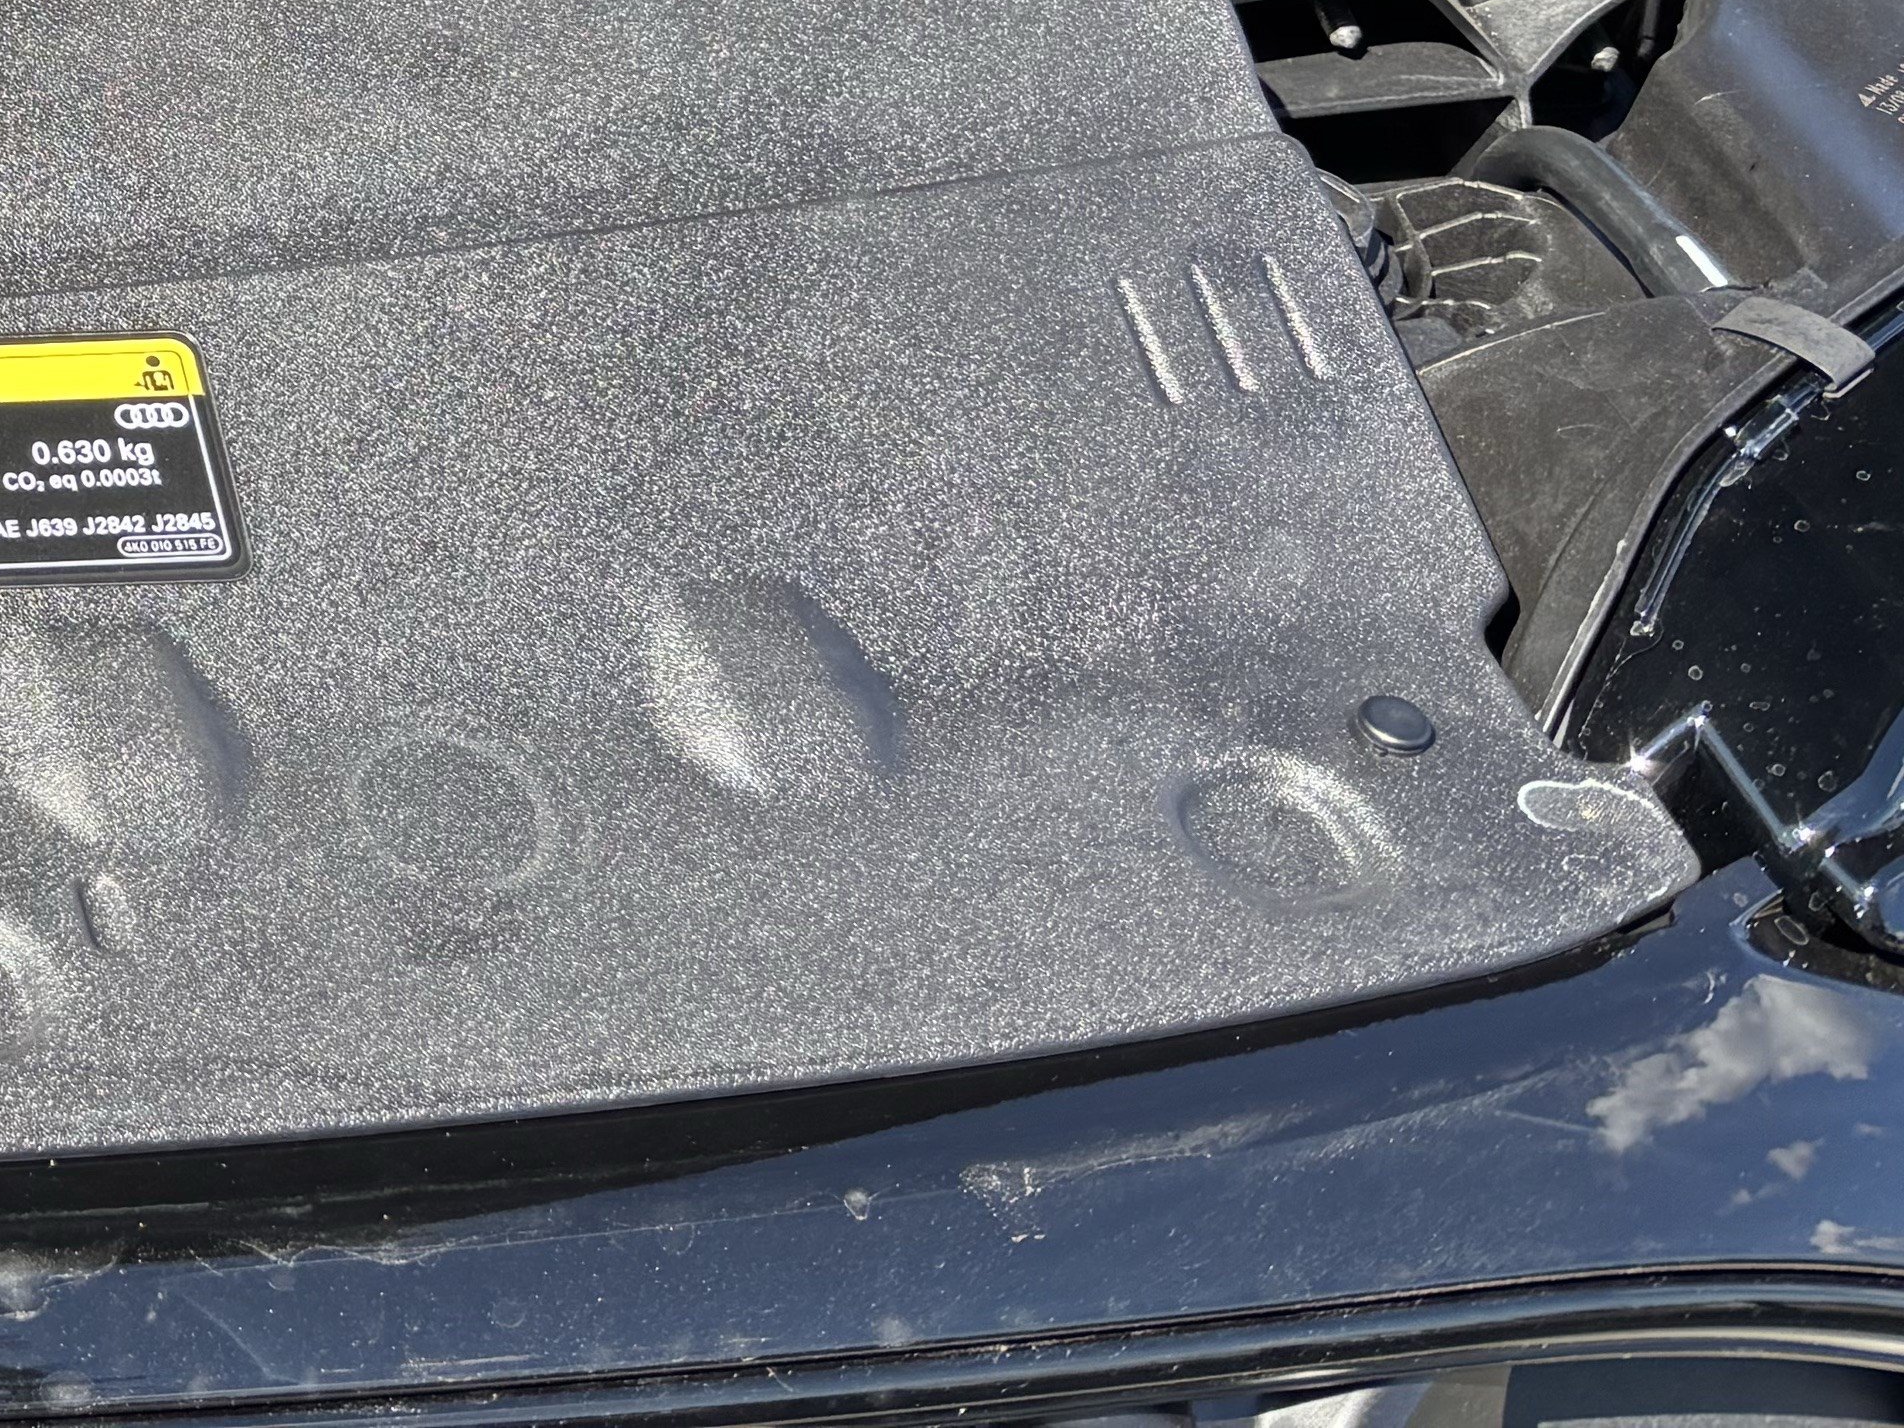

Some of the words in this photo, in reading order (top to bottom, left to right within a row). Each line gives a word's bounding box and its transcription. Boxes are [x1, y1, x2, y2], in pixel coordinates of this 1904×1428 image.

[32, 439, 108, 466] 0.630
[117, 438, 155, 468] kg
[49, 473, 78, 492] eq
[82, 466, 162, 489] 0.0003t
[25, 517, 78, 538] J639
[82, 514, 146, 536] J2842
[149, 511, 216, 533] J2845
